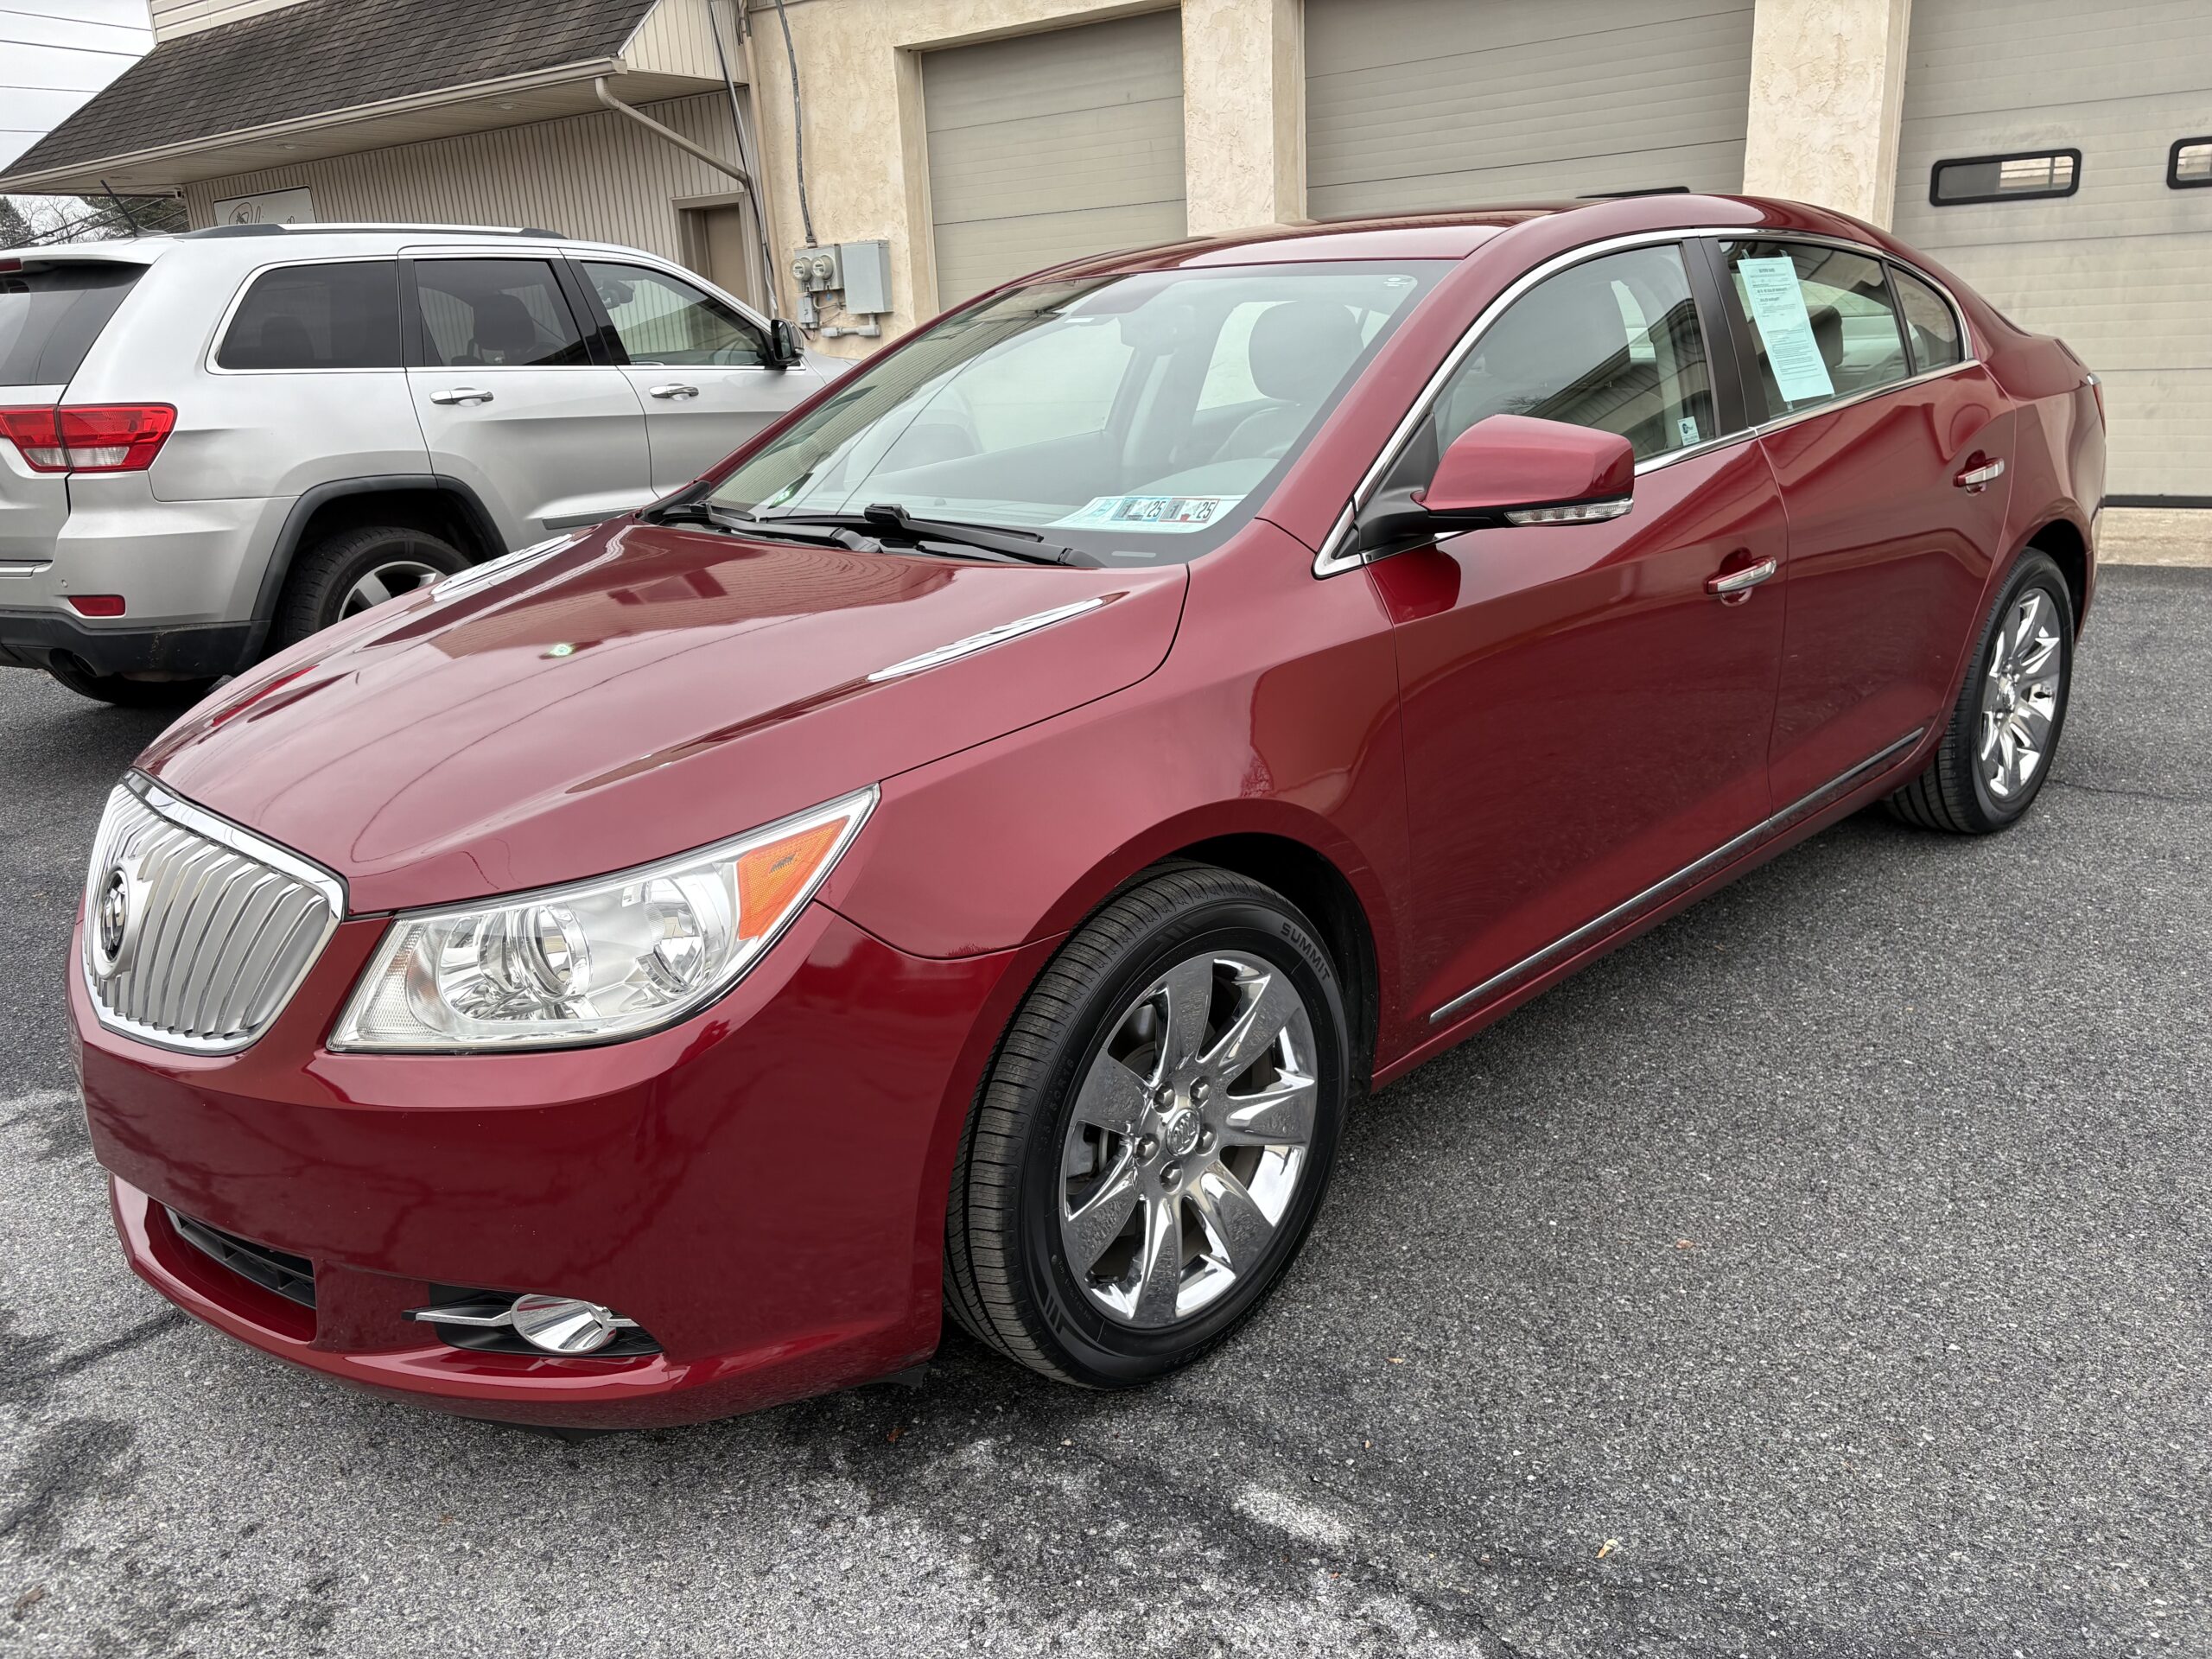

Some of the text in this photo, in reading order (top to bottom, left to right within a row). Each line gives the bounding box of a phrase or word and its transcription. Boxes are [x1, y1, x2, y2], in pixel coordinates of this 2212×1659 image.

[1147, 501, 1166, 518] 25
[1196, 501, 1216, 519] 25
[1280, 922, 1331, 981] SUMMIT
